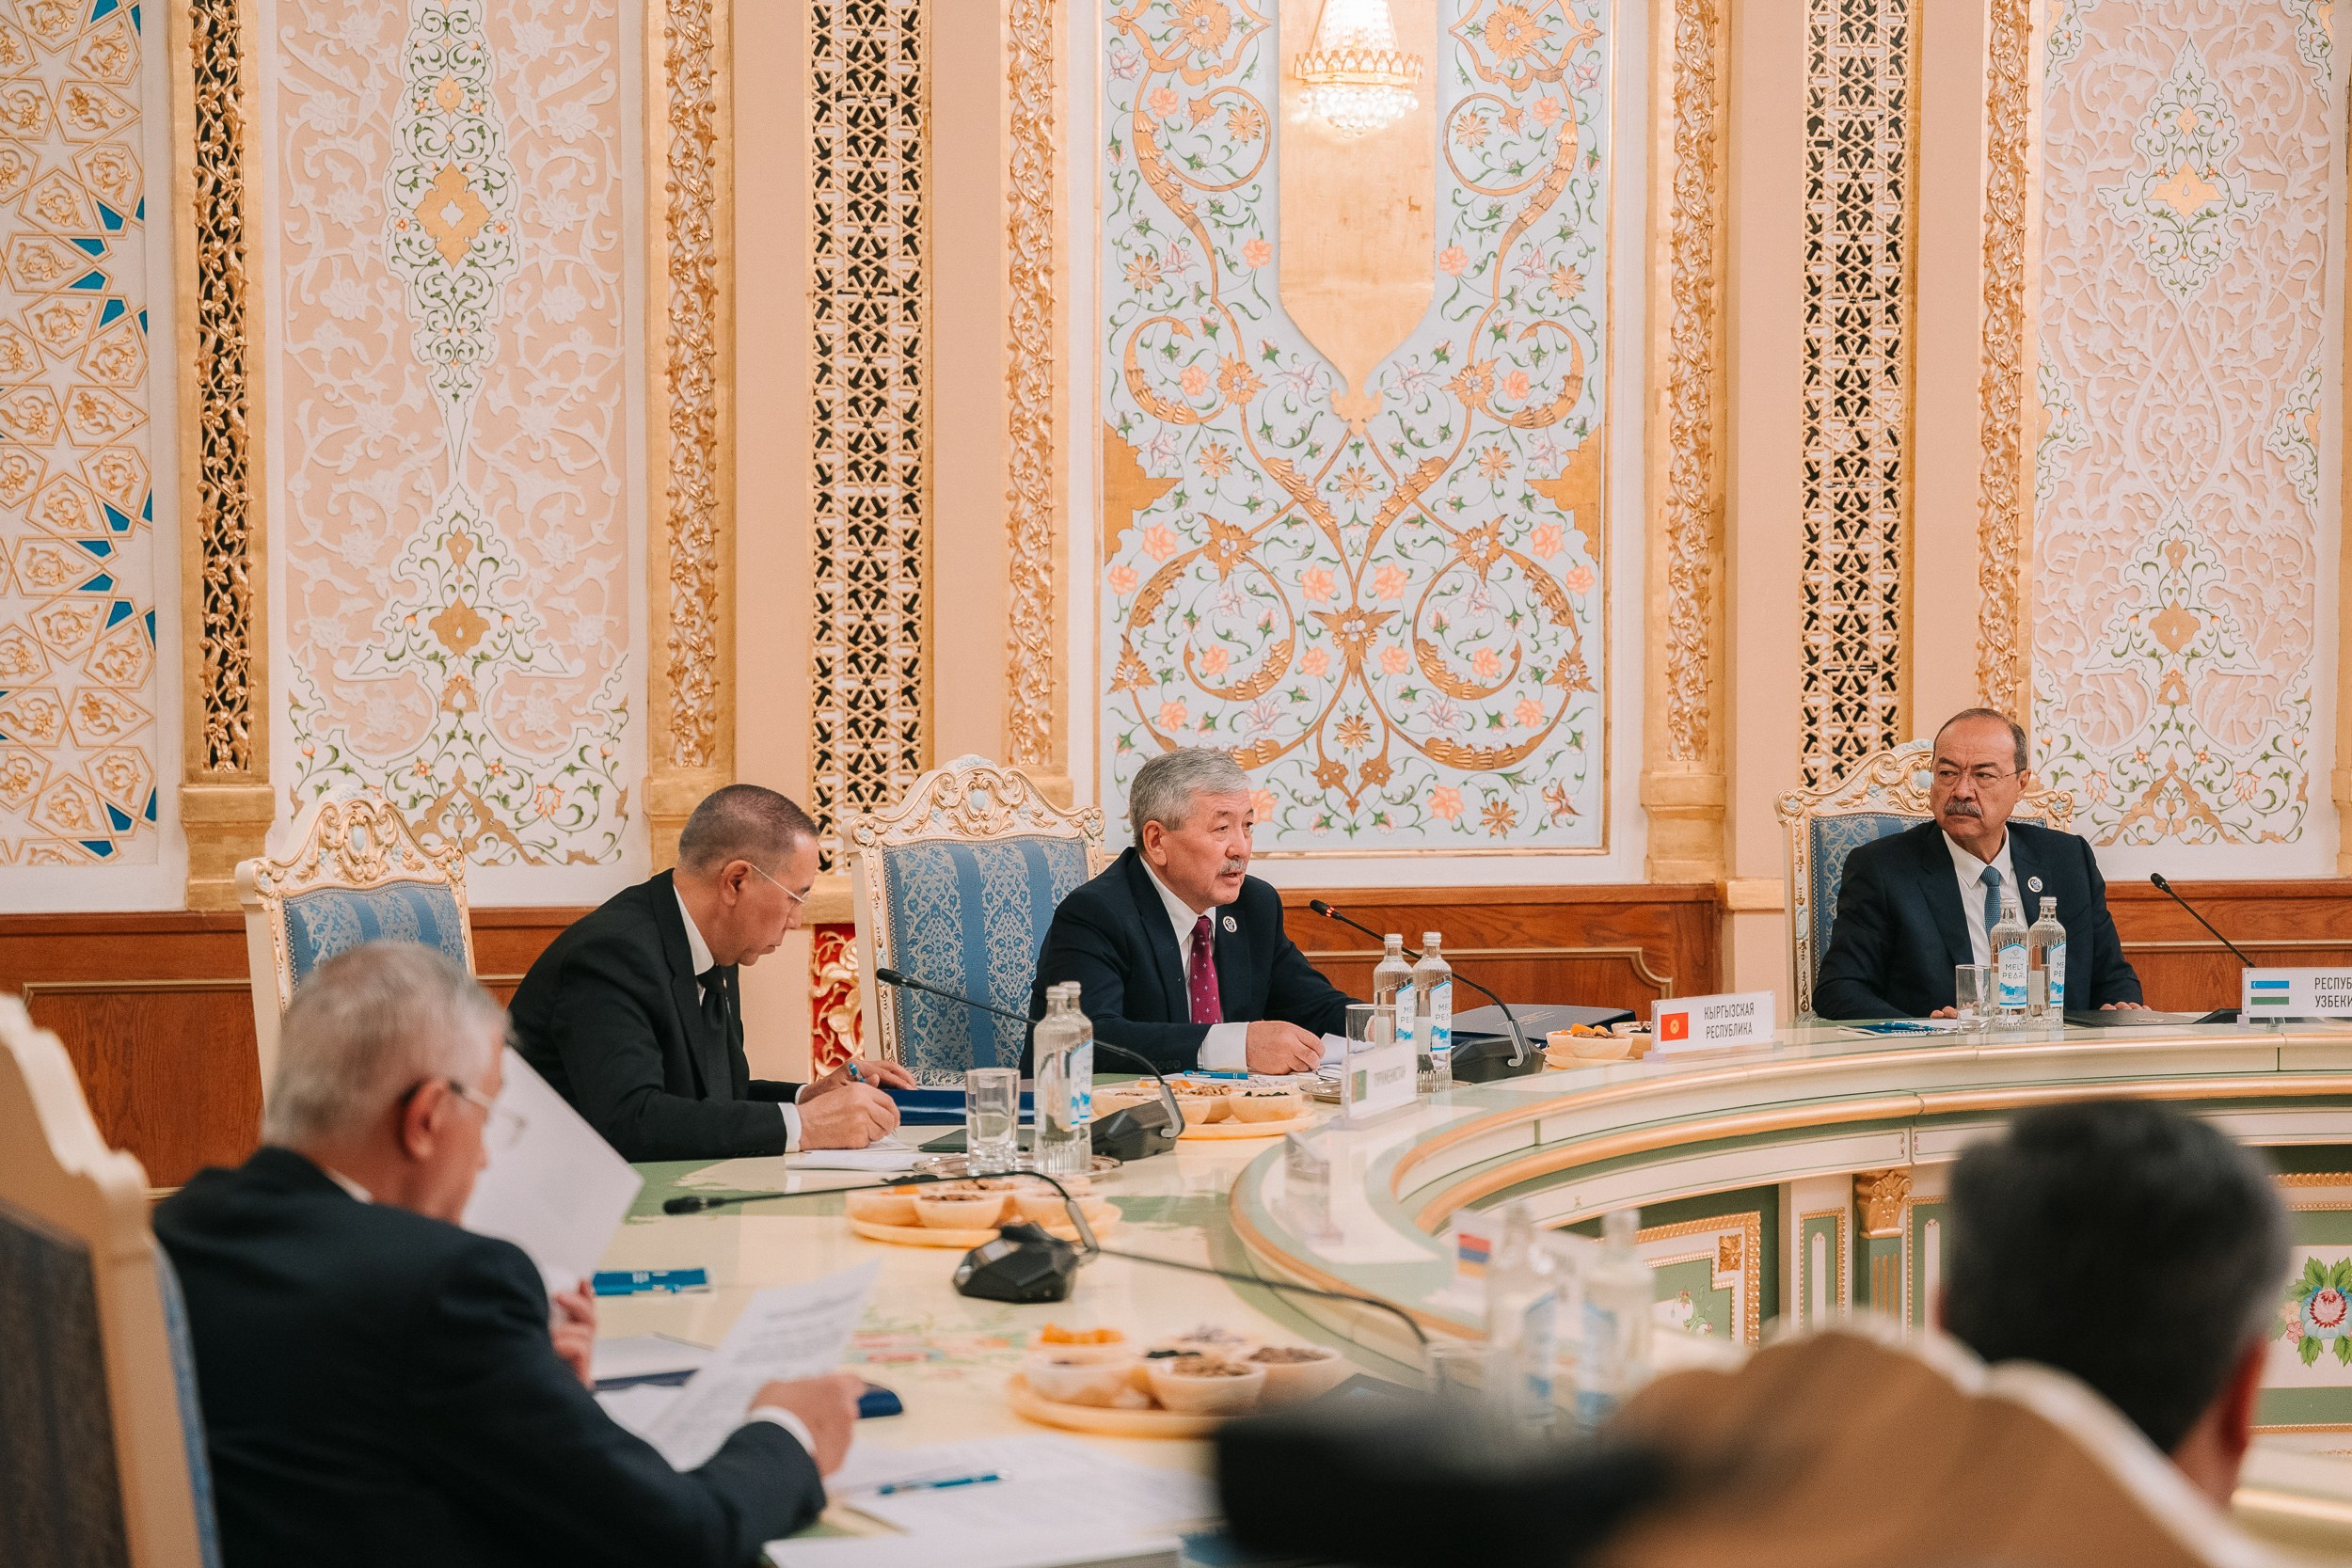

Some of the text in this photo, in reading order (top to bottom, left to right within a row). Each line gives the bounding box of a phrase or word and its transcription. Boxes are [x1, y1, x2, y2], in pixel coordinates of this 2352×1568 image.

[2314, 977, 2352, 990] РЕСПУБ
[1704, 1002, 1754, 1020] КЫРГЫЗСКАЯ
[1706, 1022, 1753, 1039] РЕСПУБЛИКА
